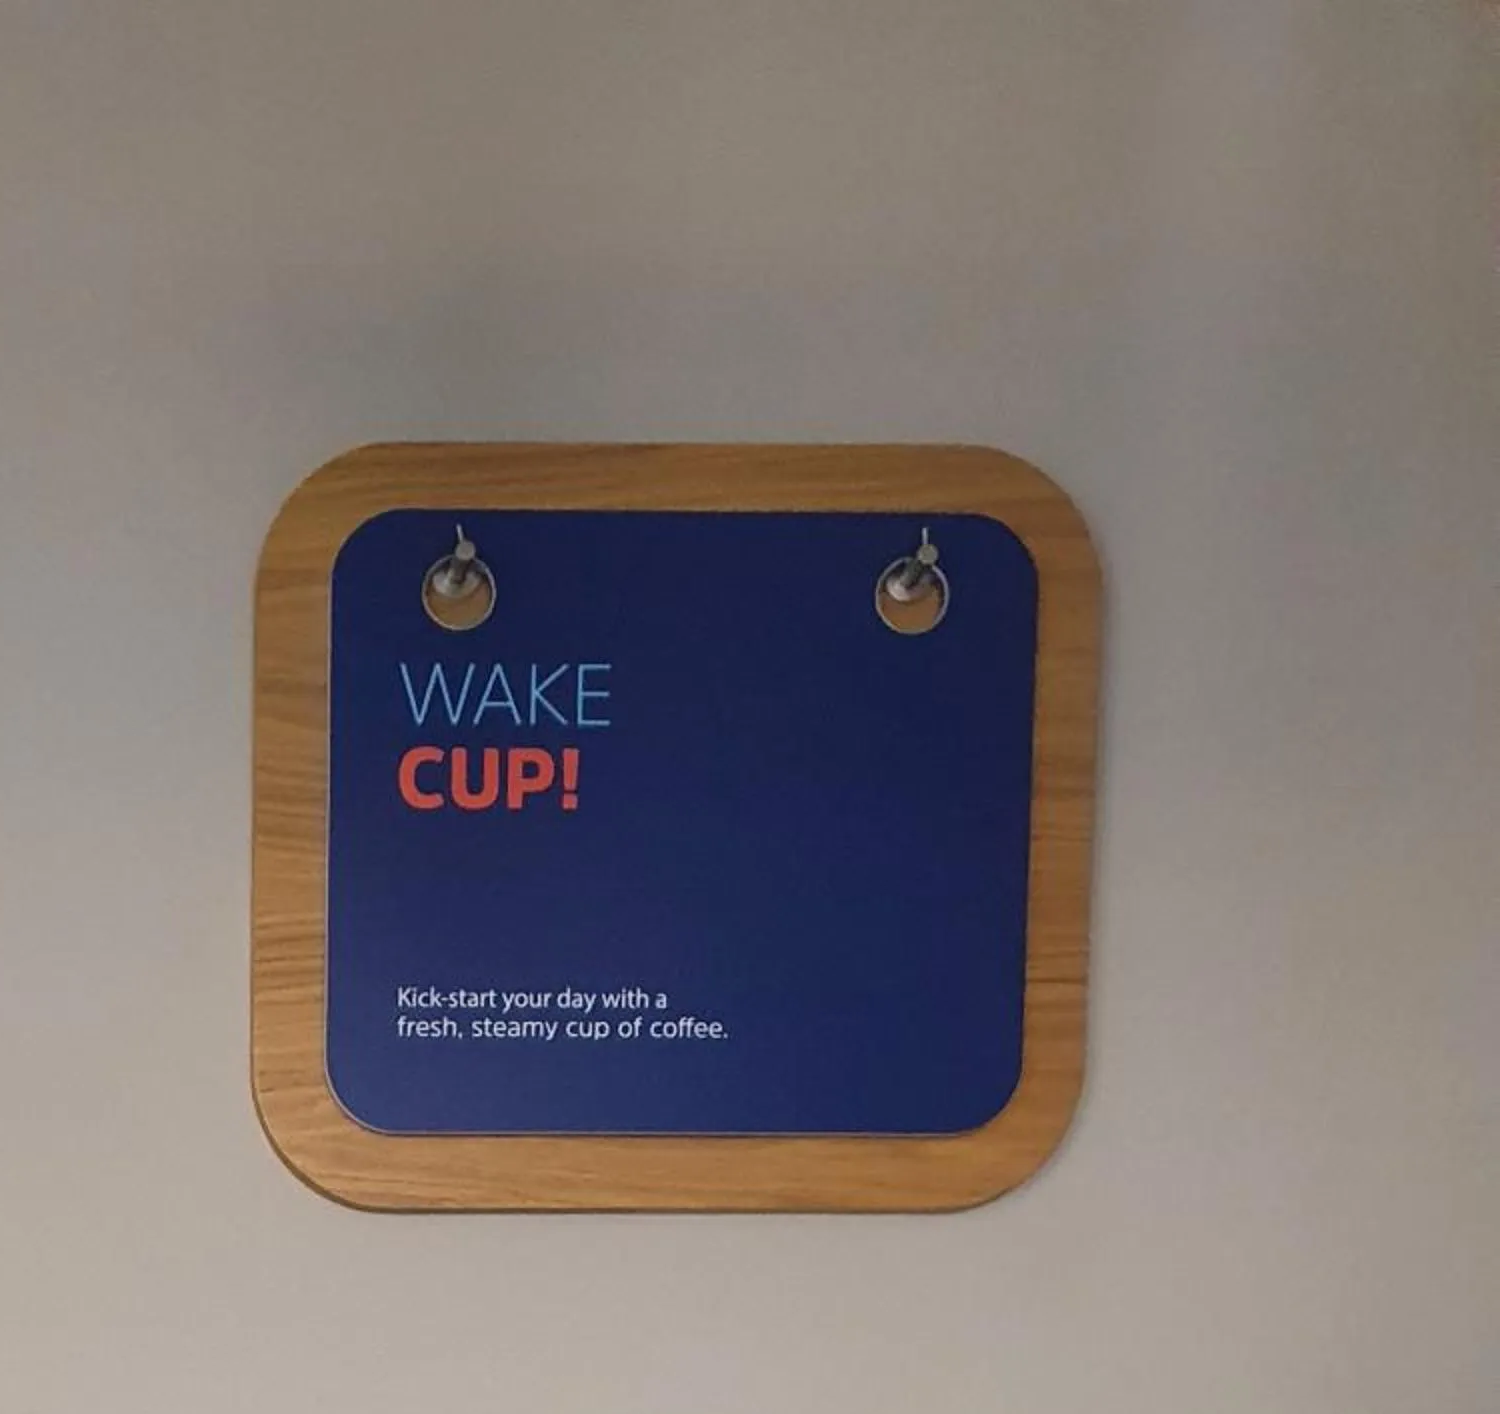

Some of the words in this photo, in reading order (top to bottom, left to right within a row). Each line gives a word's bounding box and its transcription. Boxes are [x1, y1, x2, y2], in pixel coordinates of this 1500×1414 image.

[400, 662, 611, 726] WAKE
[398, 746, 579, 810] CUP!
[397, 986, 498, 1008] Kick-start
[501, 992, 552, 1014] your
[557, 986, 596, 1014] day
[601, 987, 649, 1009] with
[655, 993, 667, 1009] a
[397, 1016, 463, 1039] fresh,
[471, 1017, 559, 1041] steamy
[565, 1020, 610, 1040] cup
[617, 1016, 643, 1038] of
[649, 1016, 729, 1039] coffee.
